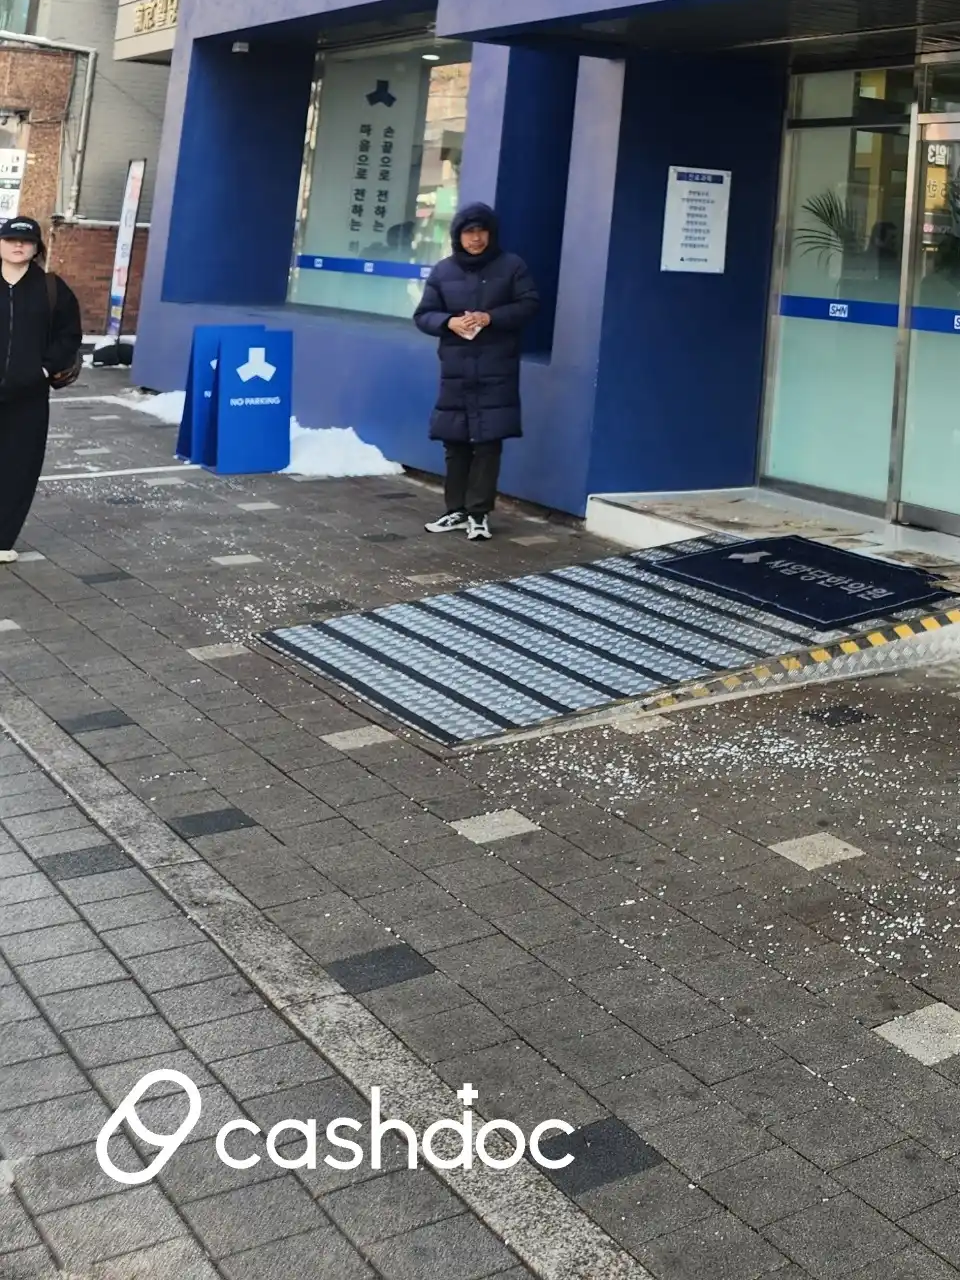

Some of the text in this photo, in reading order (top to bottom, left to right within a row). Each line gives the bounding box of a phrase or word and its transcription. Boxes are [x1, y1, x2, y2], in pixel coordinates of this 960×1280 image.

[830, 305, 848, 317] SHN
[230, 396, 281, 407] NO PARKING
